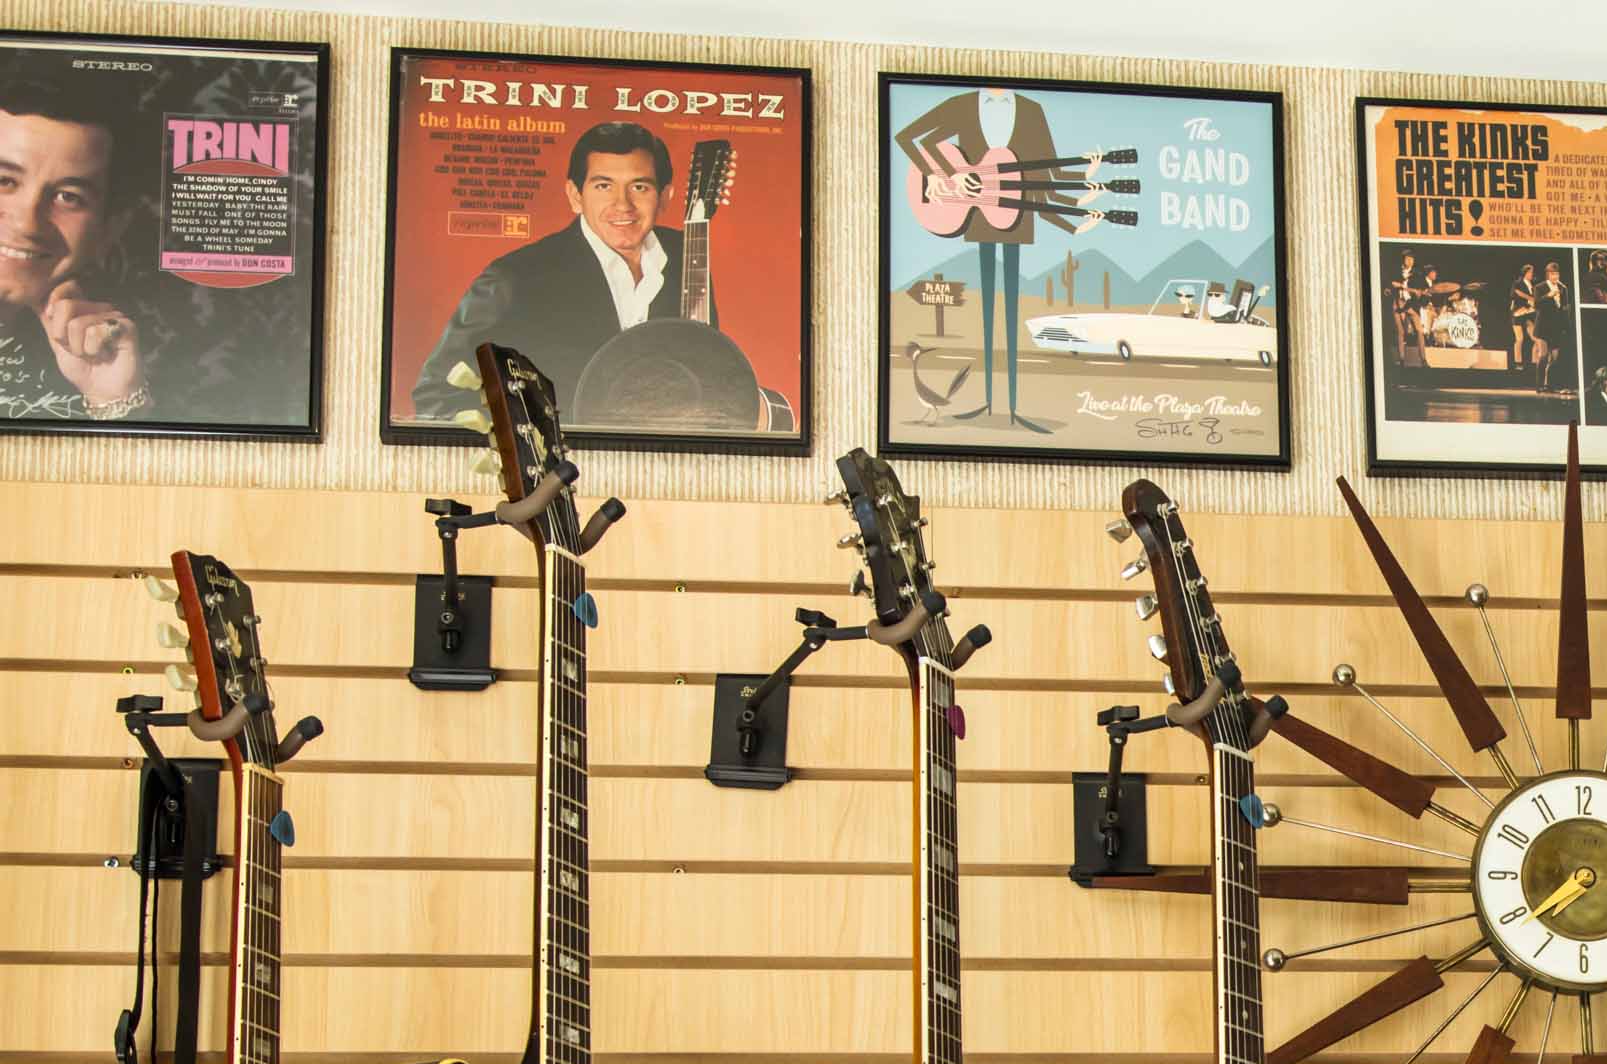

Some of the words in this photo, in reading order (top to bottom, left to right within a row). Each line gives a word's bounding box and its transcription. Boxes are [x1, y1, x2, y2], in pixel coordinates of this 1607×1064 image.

[72, 60, 152, 71] STEREO
[420, 76, 589, 109] TRINI
[614, 88, 784, 120] LOPEZ
[419, 112, 448, 128] the
[456, 112, 500, 131] latin
[508, 117, 566, 133] album
[1184, 118, 1221, 140] The
[169, 118, 290, 172] TRINI
[1394, 120, 1449, 157] THE
[1456, 122, 1549, 161] KINKS
[1160, 145, 1249, 185] GAND
[1554, 154, 1560, 164] A
[1395, 159, 1538, 200] GREATEST
[1546, 166, 1573, 176] TIRED
[1576, 167, 1587, 177] OF
[1546, 179, 1566, 188] AND
[1568, 180, 1585, 189] ALL
[1589, 181, 1600, 190] OF
[1546, 192, 1565, 201] GOT
[1570, 192, 1585, 202] ME
[1594, 194, 1601, 203] A
[1161, 192, 1250, 232] BAND
[1488, 202, 1528, 212] WHO'LL
[1530, 204, 1542, 213] BE
[1548, 204, 1564, 214] THE
[1571, 205, 1596, 216] NEXT
[1546, 218, 1579, 227] HAPPY
[922, 293, 954, 304] THEATRE
[926, 283, 950, 293] PLAZA
[1128, 395, 1153, 413] the
[1153, 394, 1202, 420] Plaza
[1204, 396, 1262, 417] Theatre
[1531, 794, 1556, 824] 11
[1575, 785, 1592, 816] 12
[1497, 824, 1530, 850] 10
[1488, 870, 1518, 880] 9
[1500, 906, 1527, 925] 8
[1533, 932, 1554, 959] 7
[1579, 943, 1589, 974] 6
